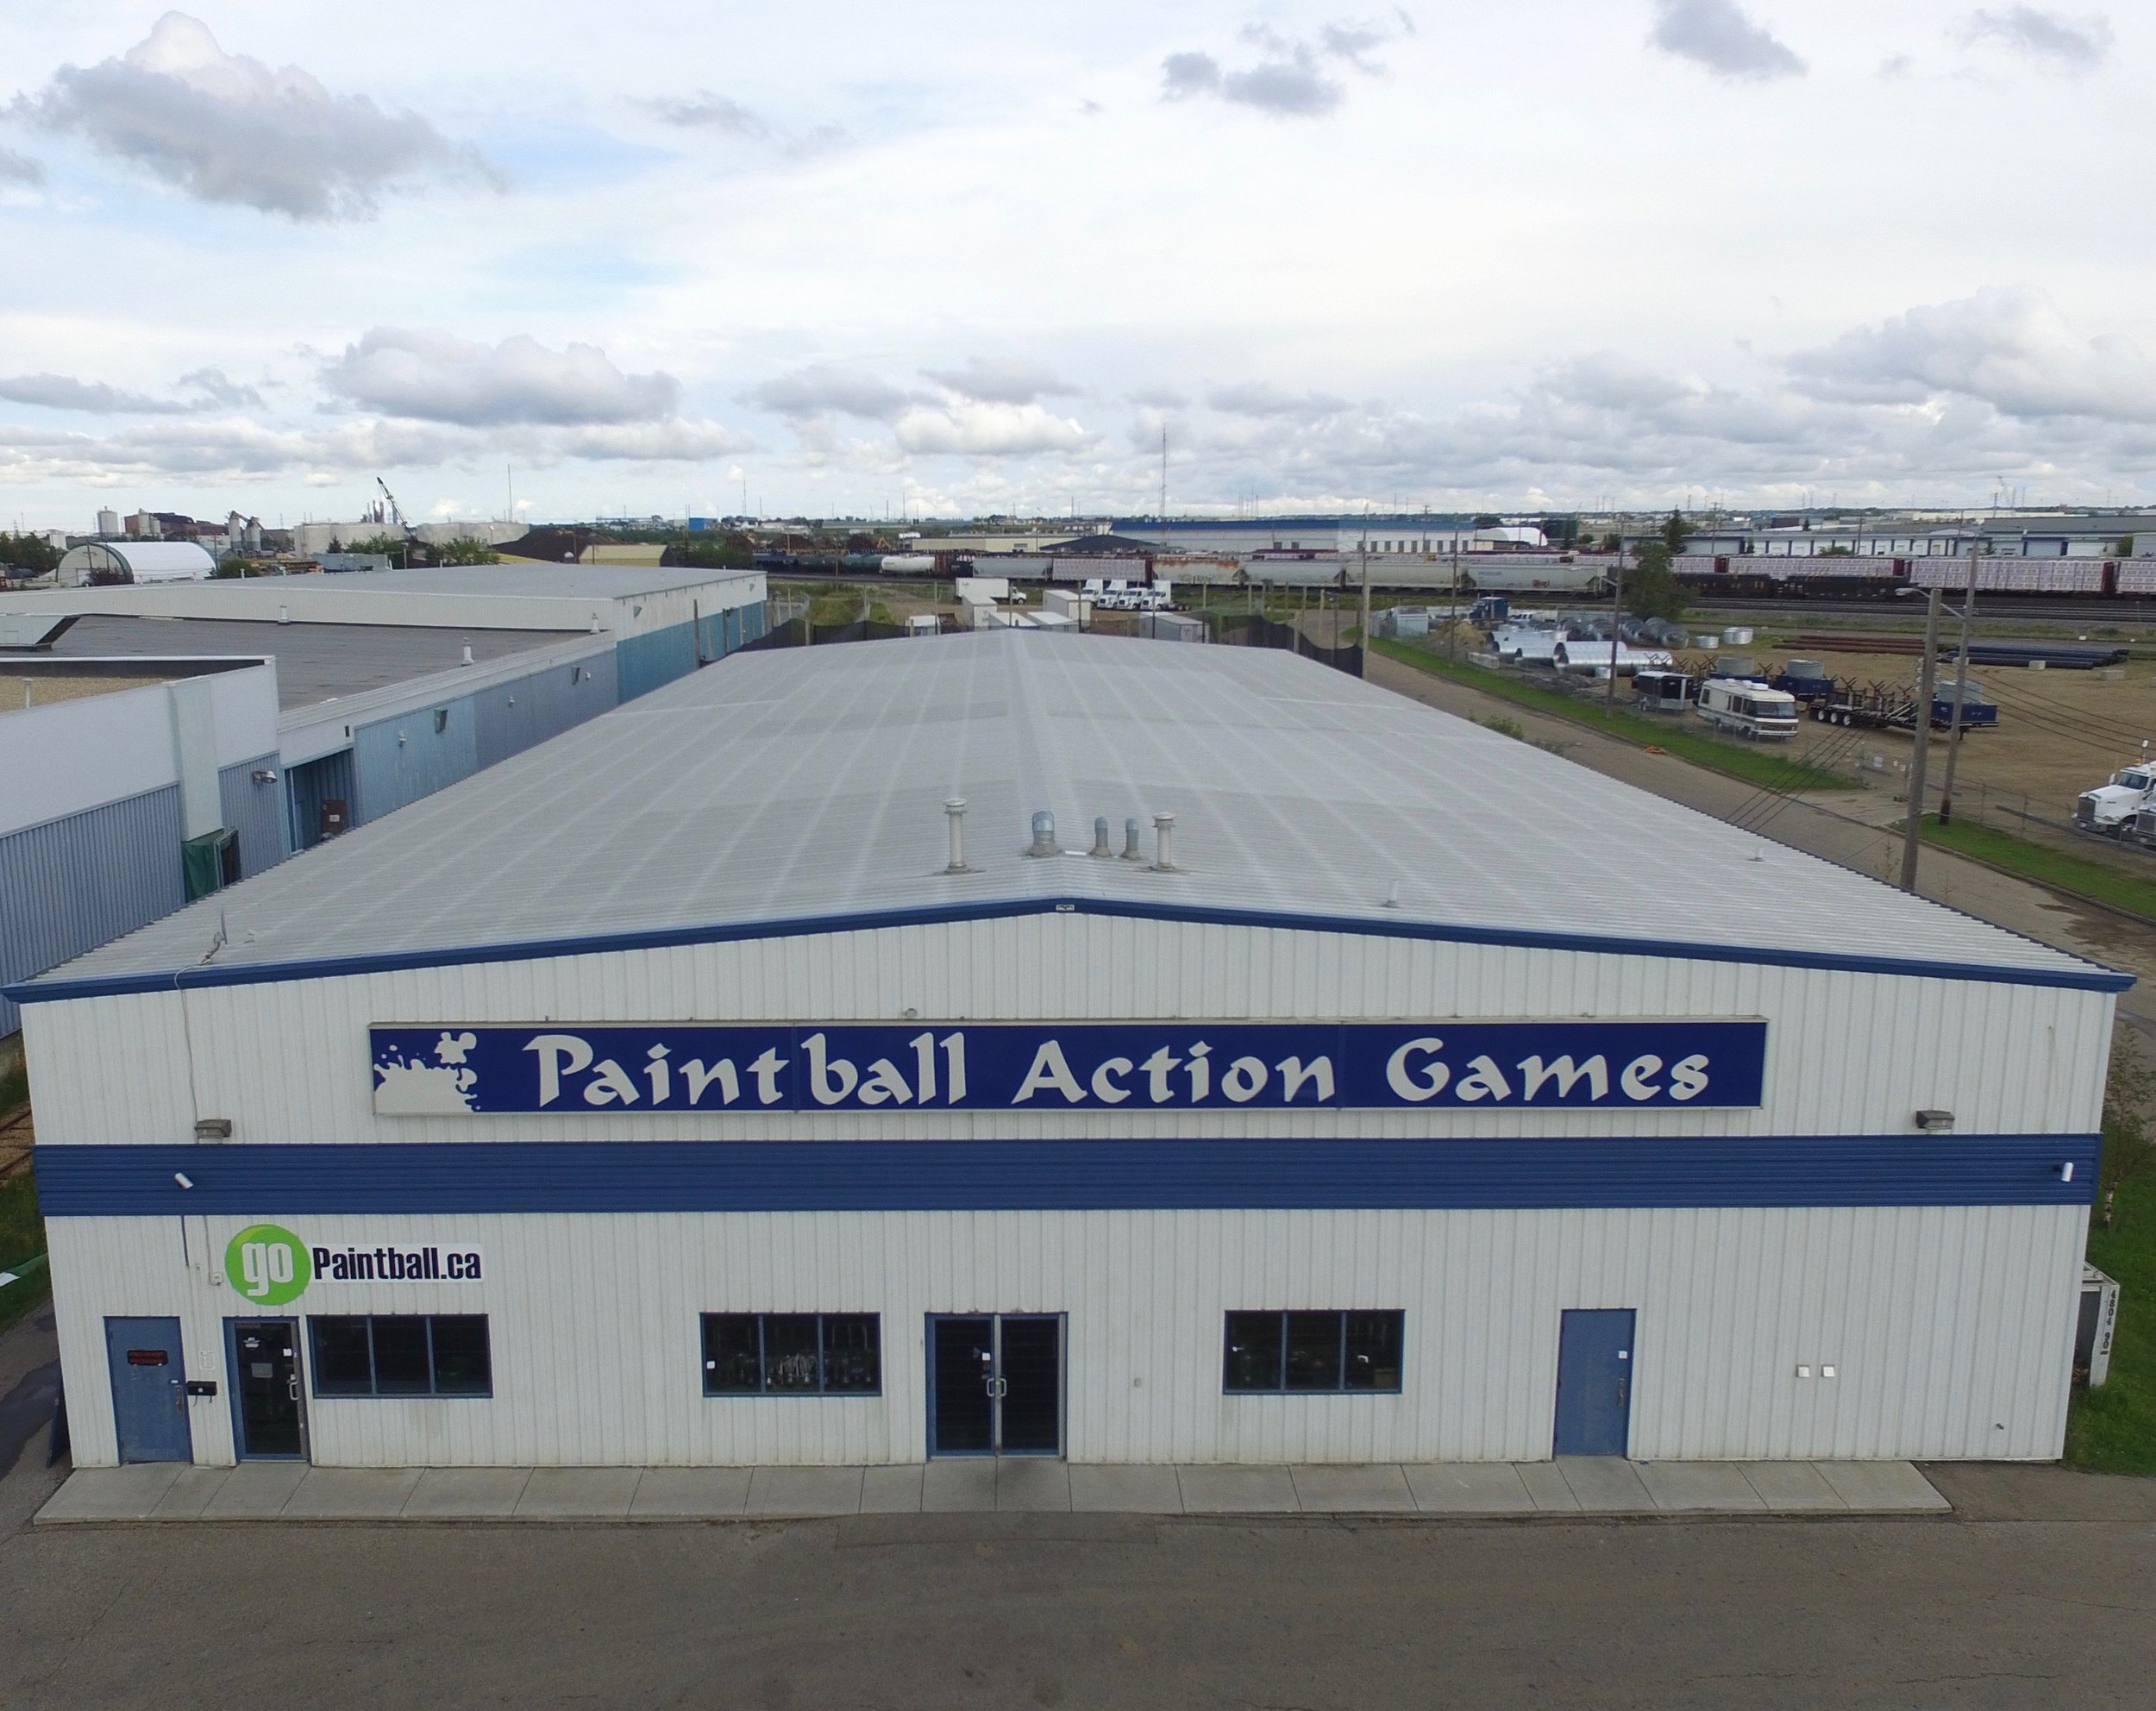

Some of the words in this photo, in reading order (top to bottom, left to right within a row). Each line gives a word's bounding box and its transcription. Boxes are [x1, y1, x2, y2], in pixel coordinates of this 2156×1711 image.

[522, 1031, 967, 1108] Paintball
[1011, 1038, 1336, 1105] Action
[1386, 1037, 1709, 1103] Games
[241, 1242, 295, 1297] go
[312, 1247, 481, 1280] Paintball.ca
